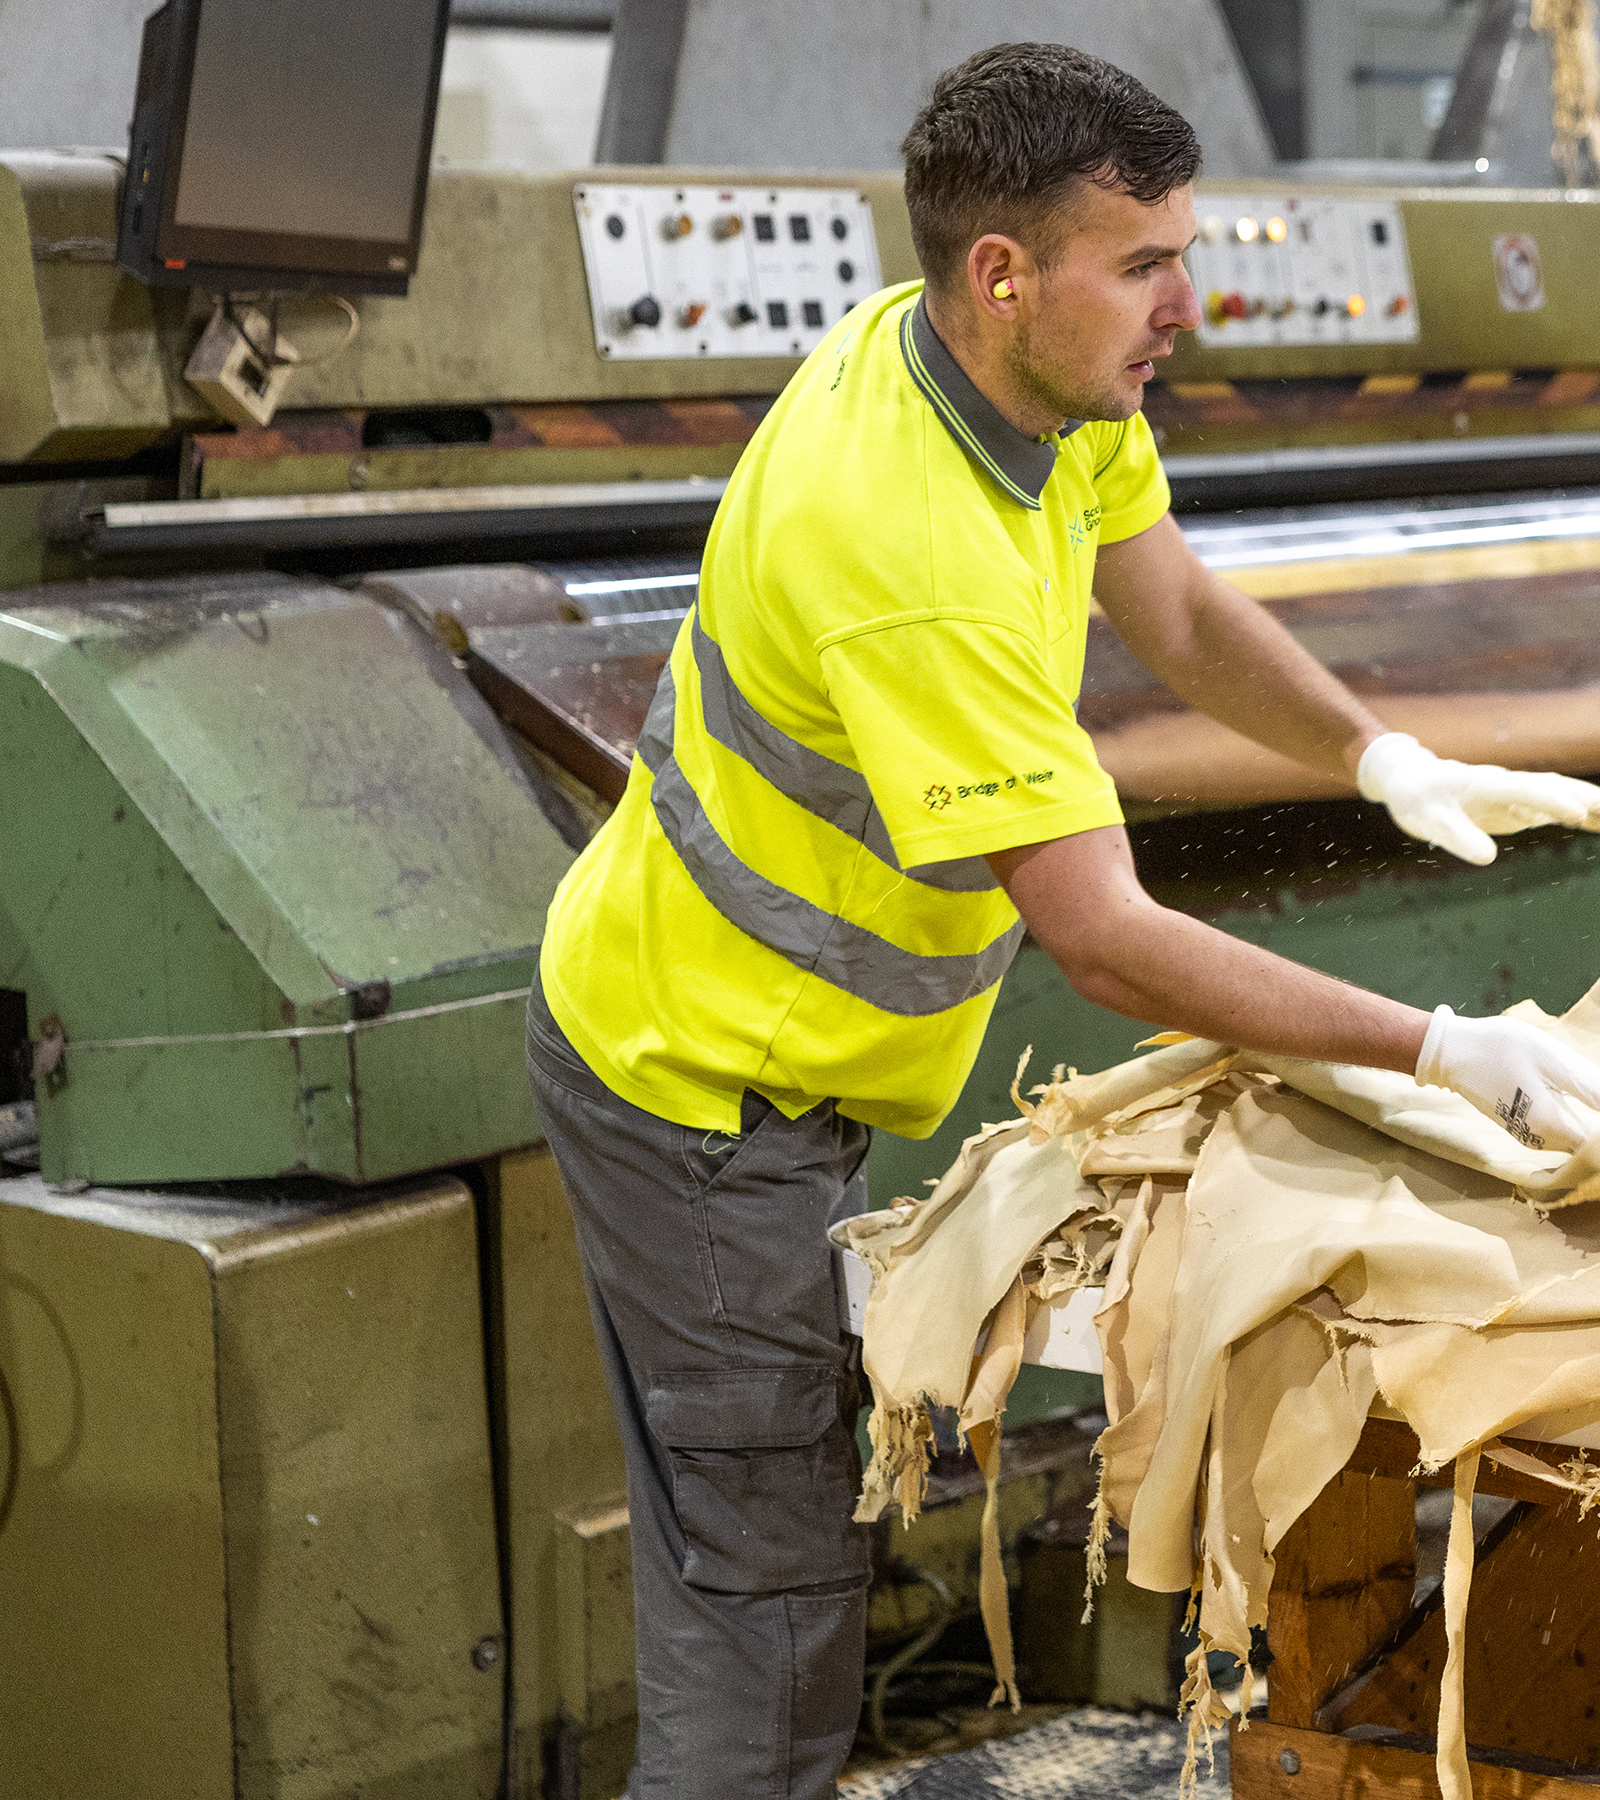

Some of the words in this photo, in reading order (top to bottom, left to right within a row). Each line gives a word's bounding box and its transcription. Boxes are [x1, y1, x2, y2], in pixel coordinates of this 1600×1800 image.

[956, 782, 999, 799] Bridge
[1005, 775, 1018, 789] of
[1022, 769, 1053, 785] Weir
